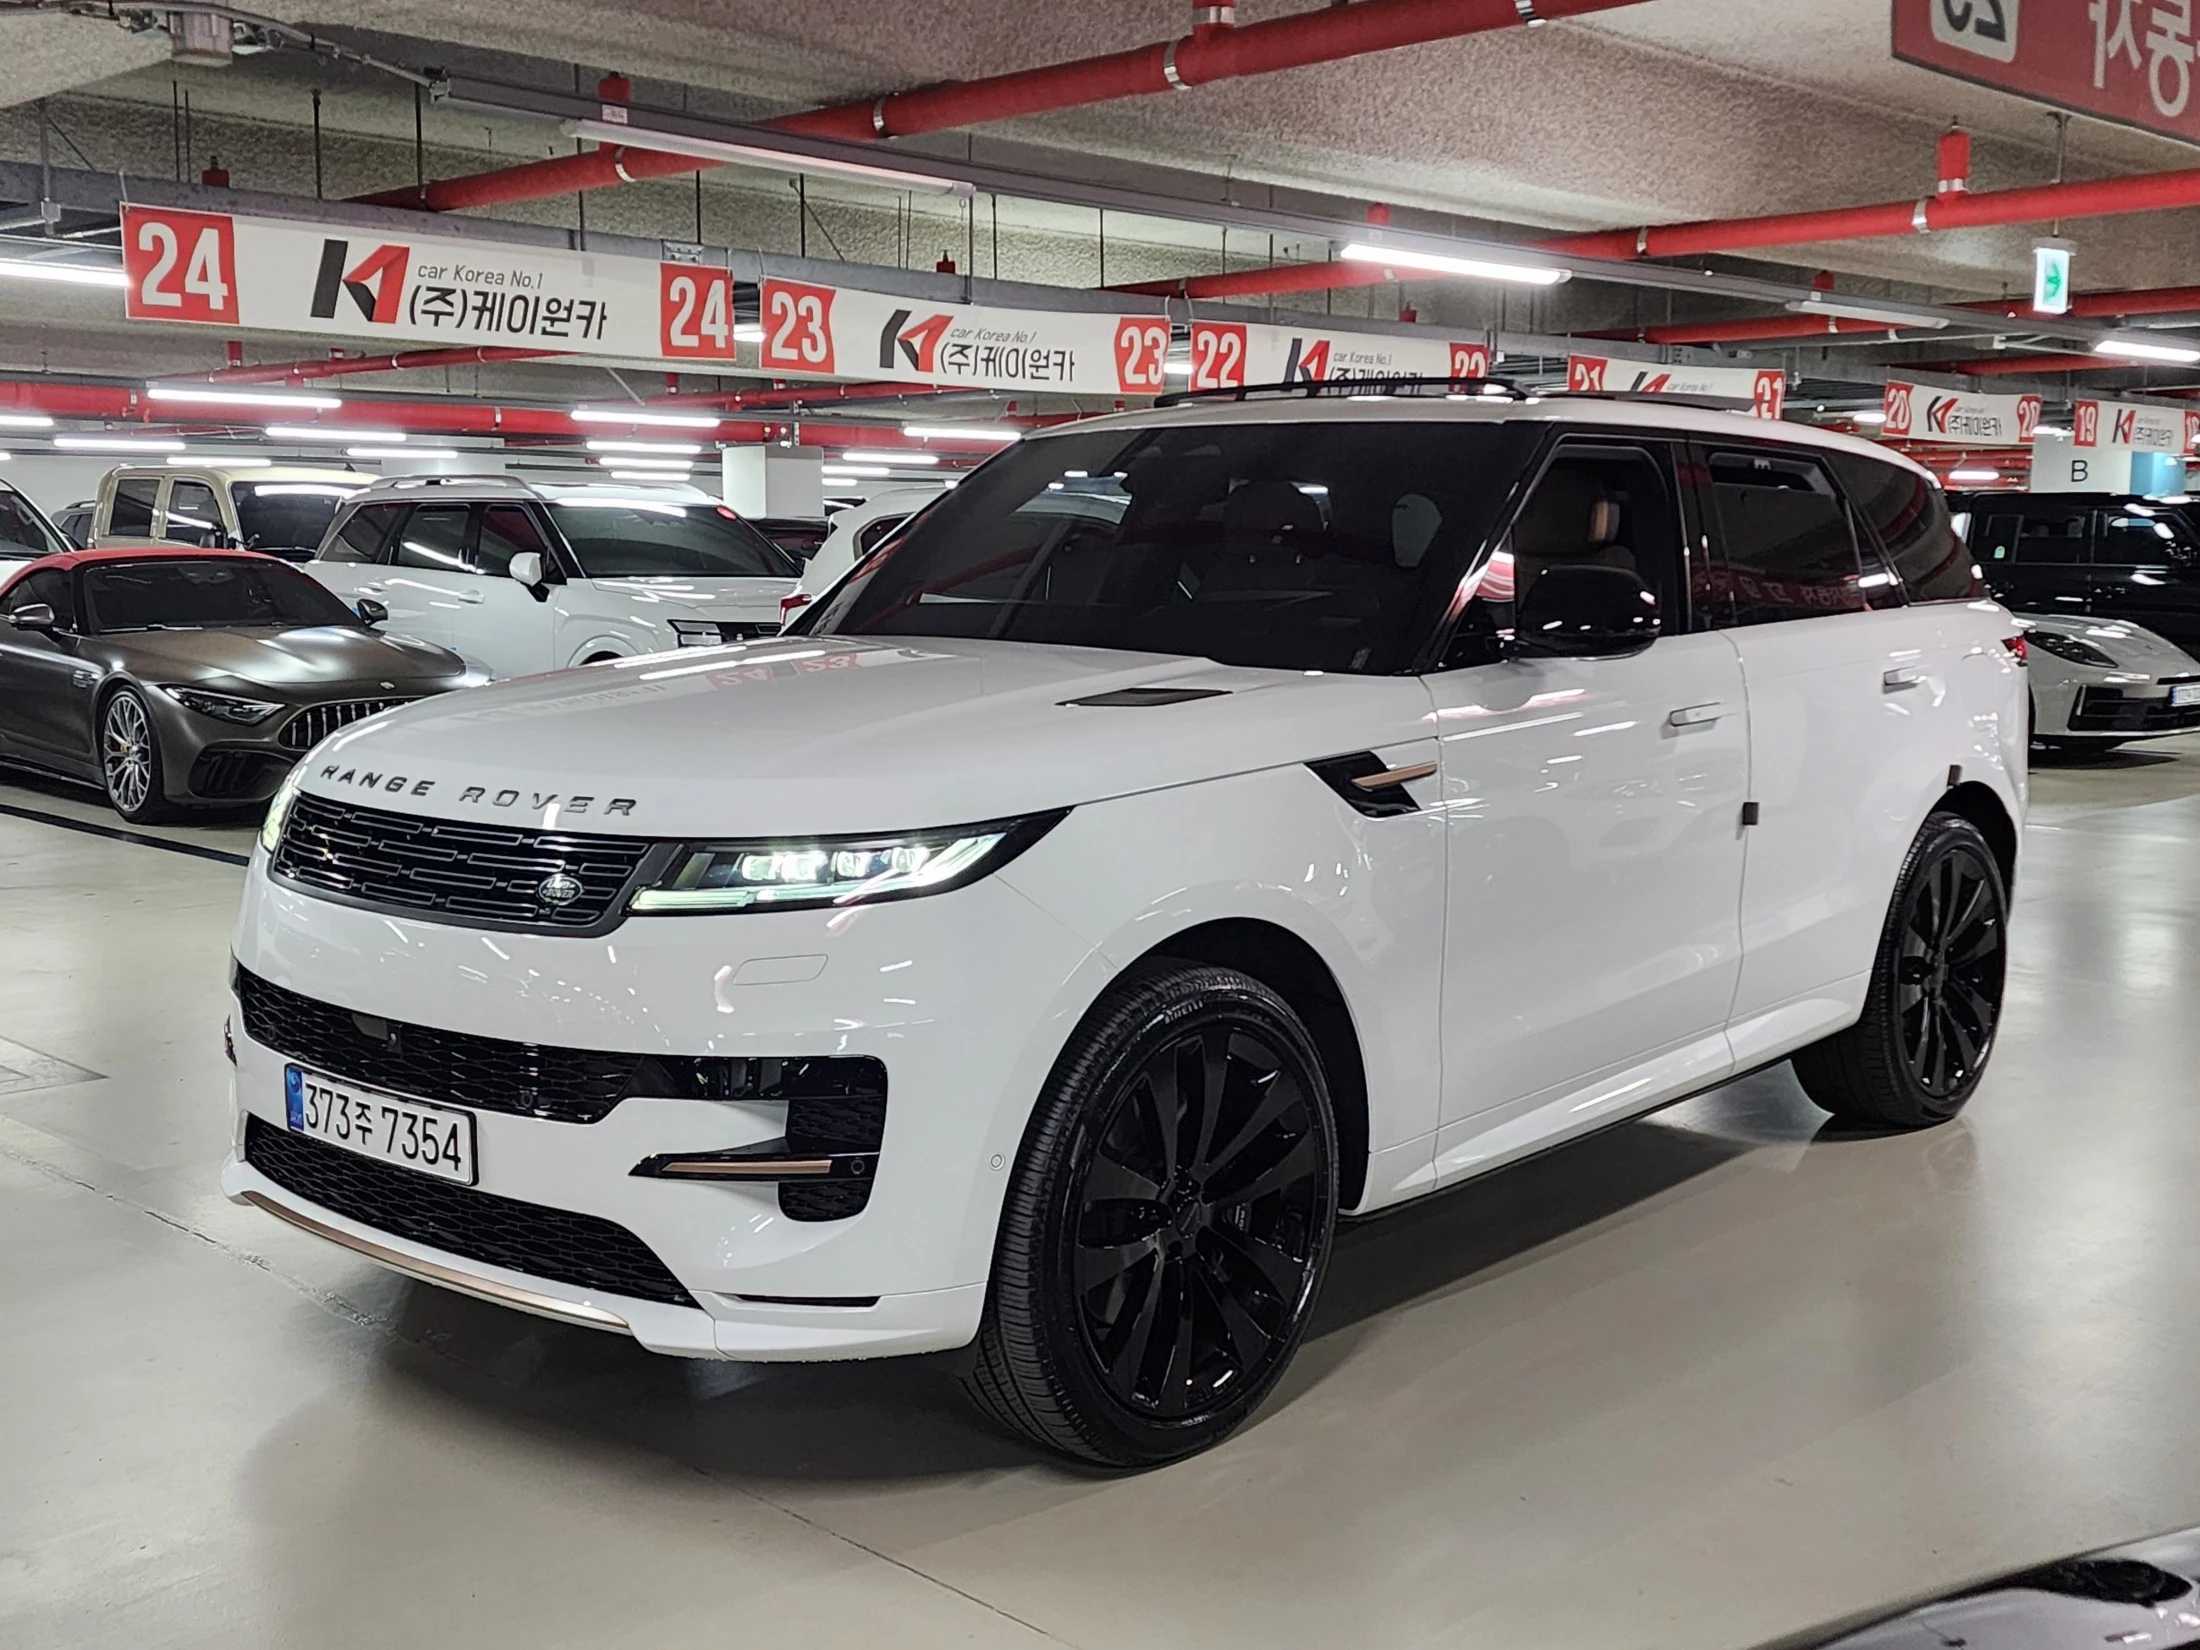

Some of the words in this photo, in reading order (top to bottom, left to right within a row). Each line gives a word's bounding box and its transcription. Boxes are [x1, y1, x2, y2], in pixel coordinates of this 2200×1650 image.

[138, 221, 229, 310] 24
[417, 263, 448, 280] car
[453, 264, 506, 286] Korea
[510, 270, 543, 290] No.1
[409, 285, 608, 340] (주)케이원카
[669, 276, 729, 349] 24
[771, 291, 828, 363] 23
[950, 327, 972, 339] car
[975, 328, 1010, 343] Korea
[1012, 331, 1037, 344] No.1
[1120, 326, 1167, 385] 23
[940, 342, 1075, 382] (주)케이원카
[1197, 330, 1242, 388] 22
[1333, 352, 1347, 363] car
[1349, 351, 1374, 365] Korea
[1376, 353, 1393, 366] No.1
[1757, 376, 1784, 420] 21
[1886, 388, 1910, 430] 20
[2019, 401, 2040, 438] 20
[2079, 405, 2096, 442] 19
[2071, 459, 2089, 483] B
[319, 764, 436, 797] RANGE
[458, 786, 637, 817] ROVER
[305, 1082, 373, 1146] 373주
[381, 1105, 462, 1172] 7354
